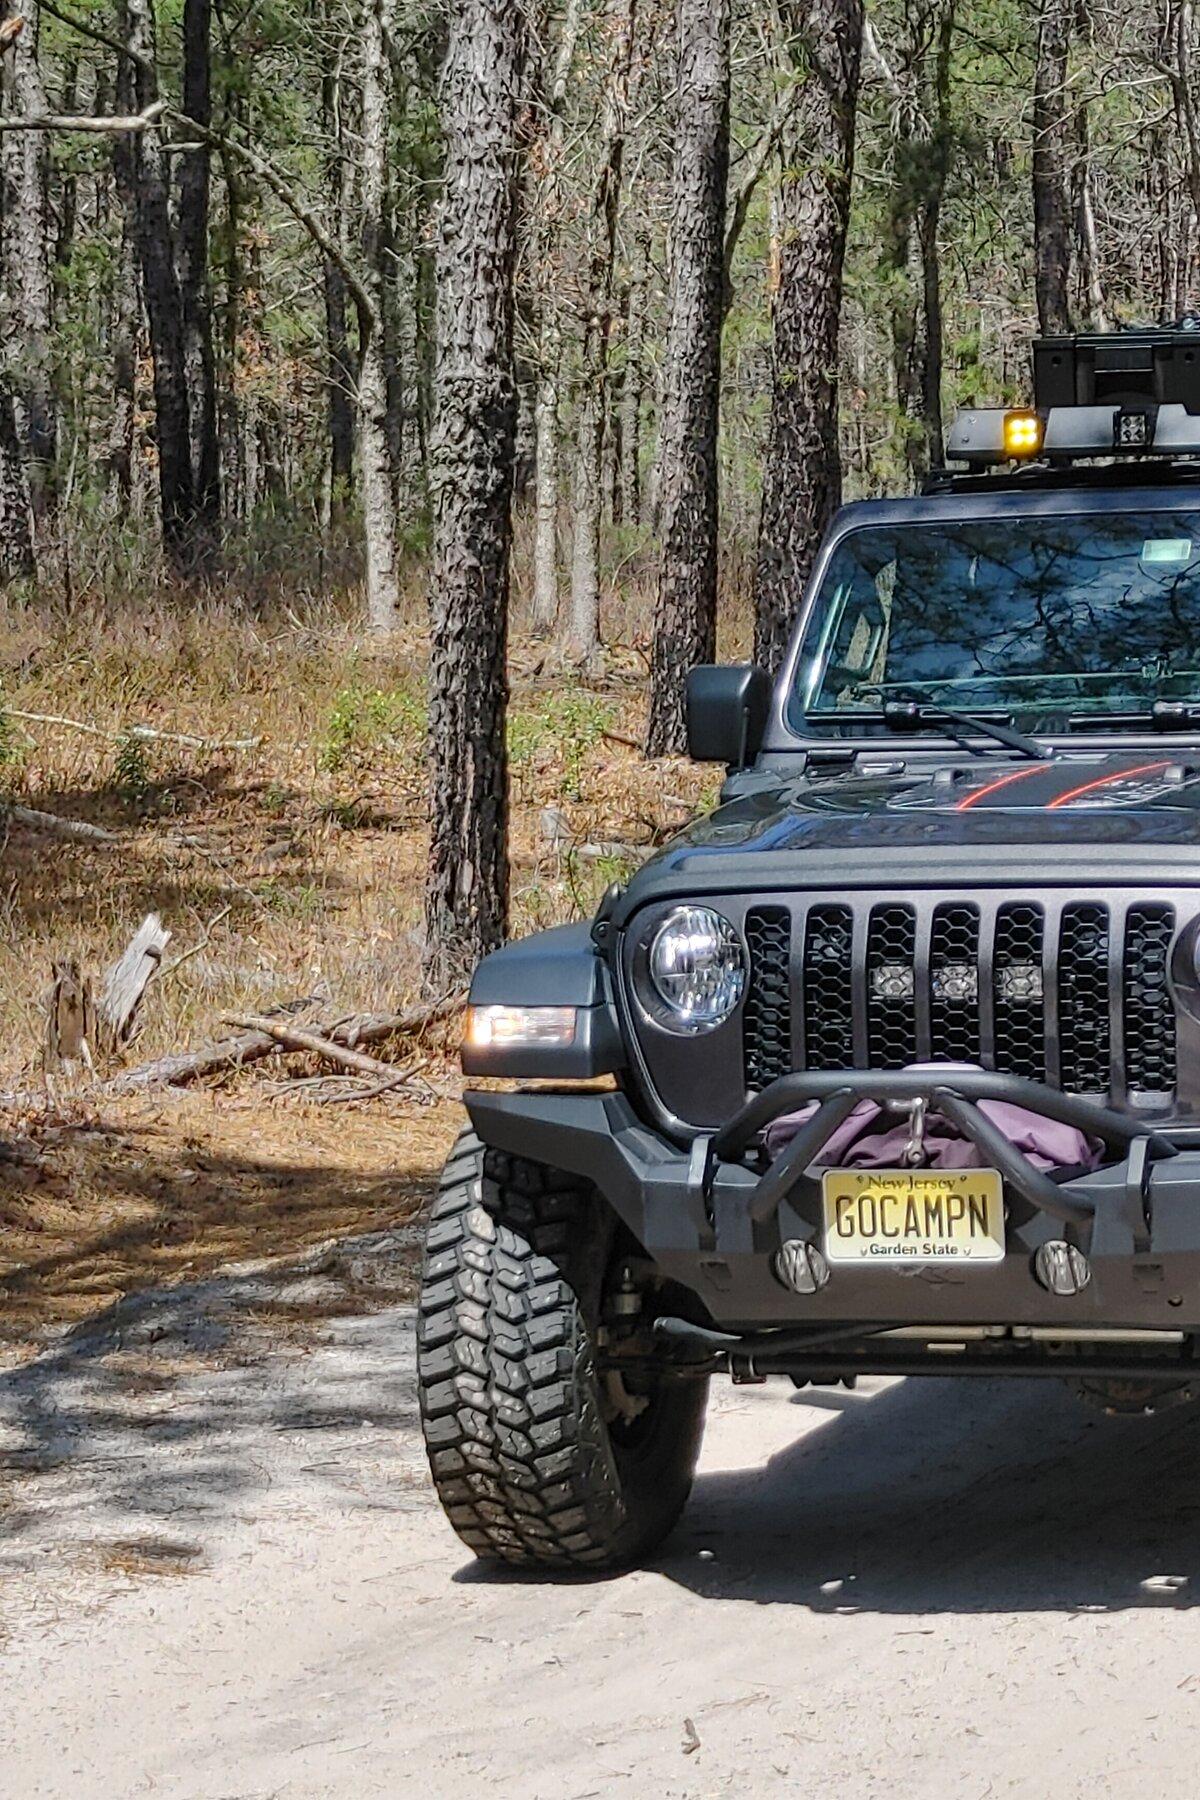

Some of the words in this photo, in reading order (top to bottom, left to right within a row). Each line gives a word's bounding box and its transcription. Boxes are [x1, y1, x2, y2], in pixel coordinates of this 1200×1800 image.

[868, 1175, 905, 1189] New
[907, 1175, 955, 1192] Jersey
[835, 1194, 990, 1238] GOCAMPN
[869, 1243, 918, 1255] Garden
[923, 1243, 958, 1255] State
